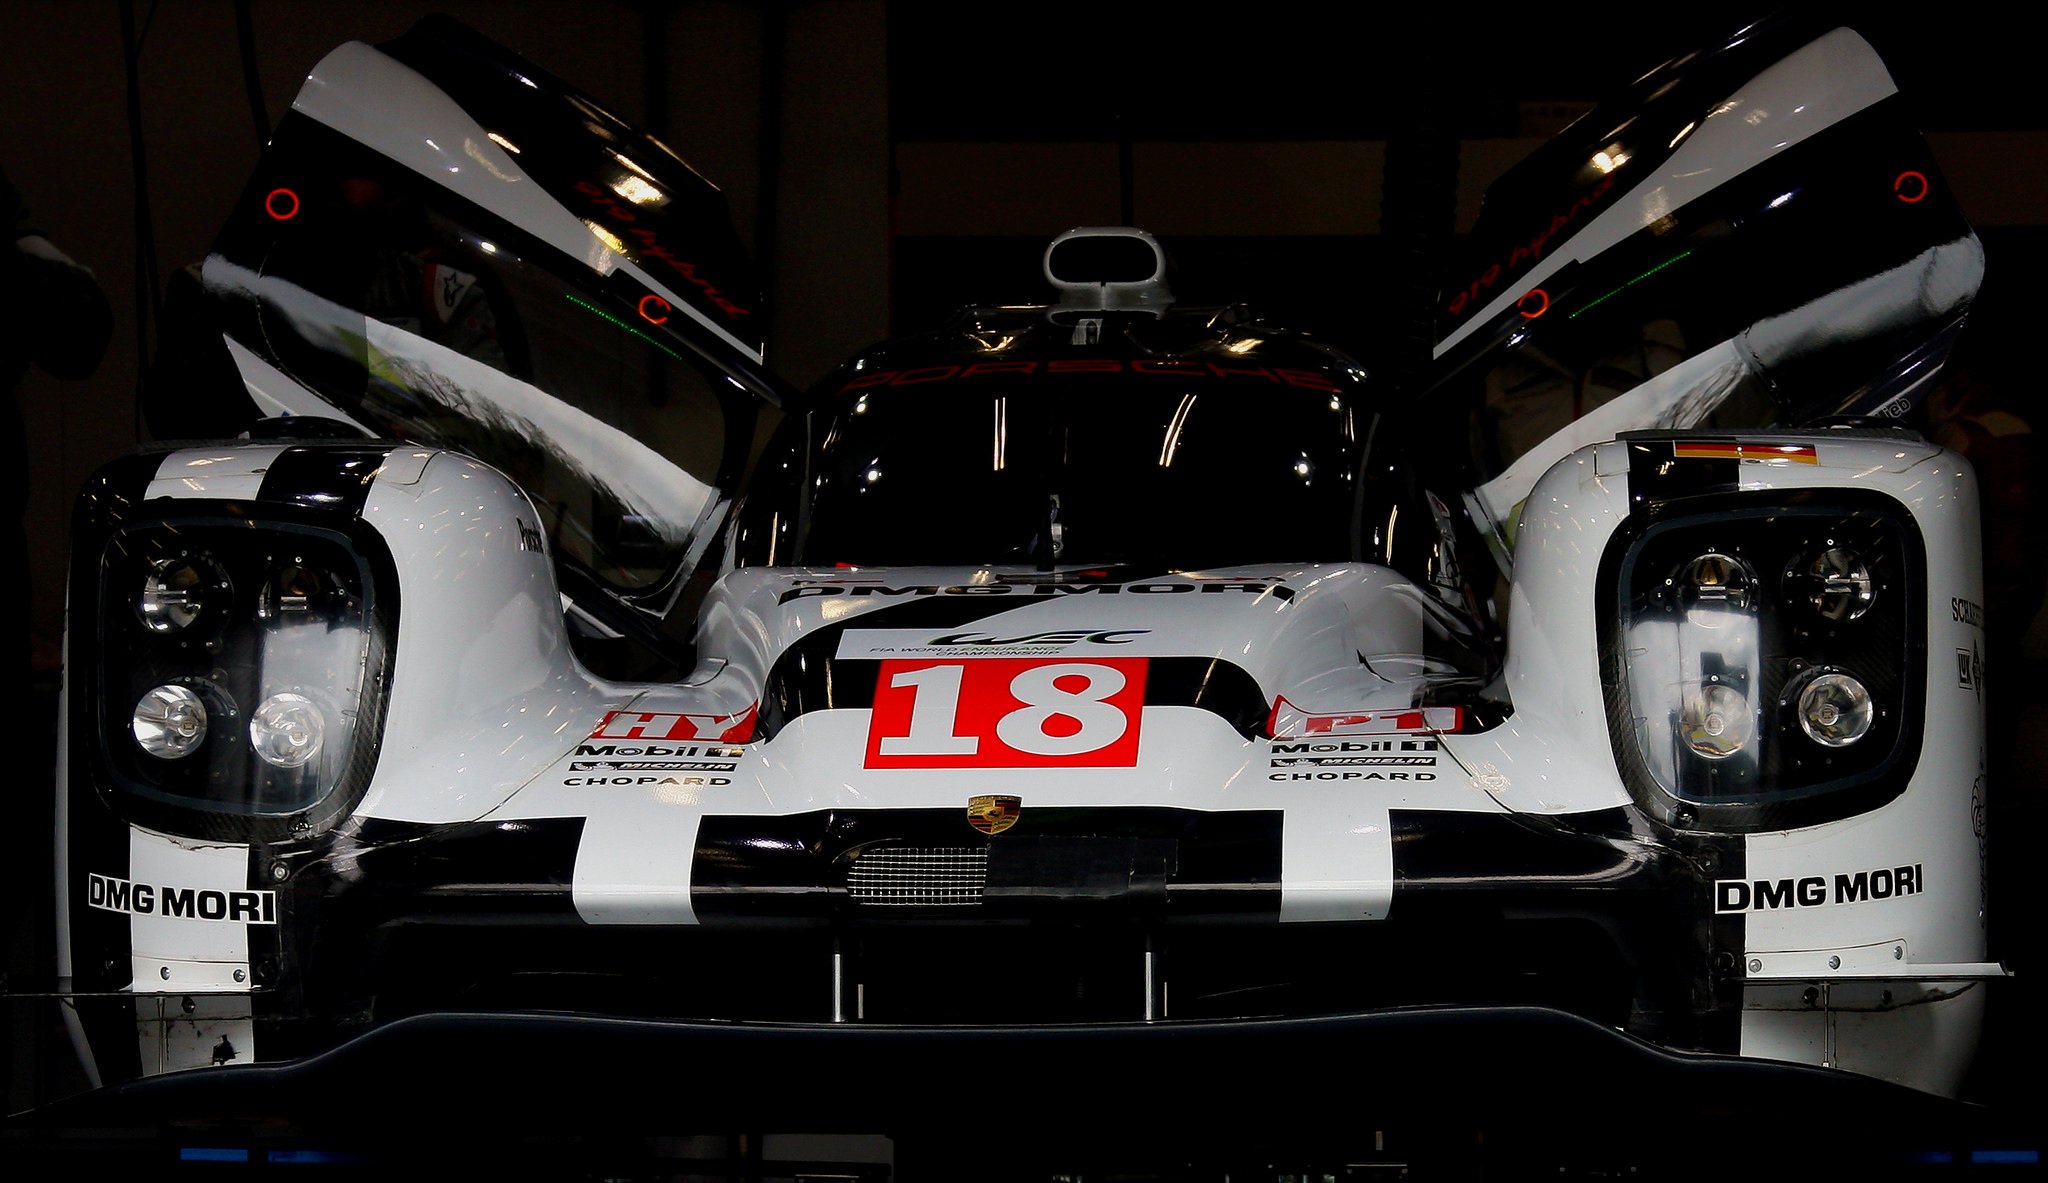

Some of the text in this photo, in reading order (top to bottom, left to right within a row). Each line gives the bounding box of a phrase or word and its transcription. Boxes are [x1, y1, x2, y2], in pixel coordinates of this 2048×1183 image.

[624, 227, 752, 319] hybrid
[832, 359, 1345, 397] PORSCHE
[777, 582, 1296, 606] DMG MORI
[927, 630, 1152, 645] WEC
[879, 664, 1128, 756] 18
[600, 713, 750, 739] HY
[1305, 712, 1424, 732] P1
[575, 746, 698, 757] Mobil
[1271, 741, 1391, 753] Mobil
[618, 762, 734, 771] MICHELIN
[1319, 757, 1434, 766] MICHELIN
[563, 777, 731, 786] CHOPARD
[1269, 772, 1436, 781] CHOPARD
[1717, 863, 1923, 912] DMG MORI
[90, 874, 274, 922] DMG MORI
